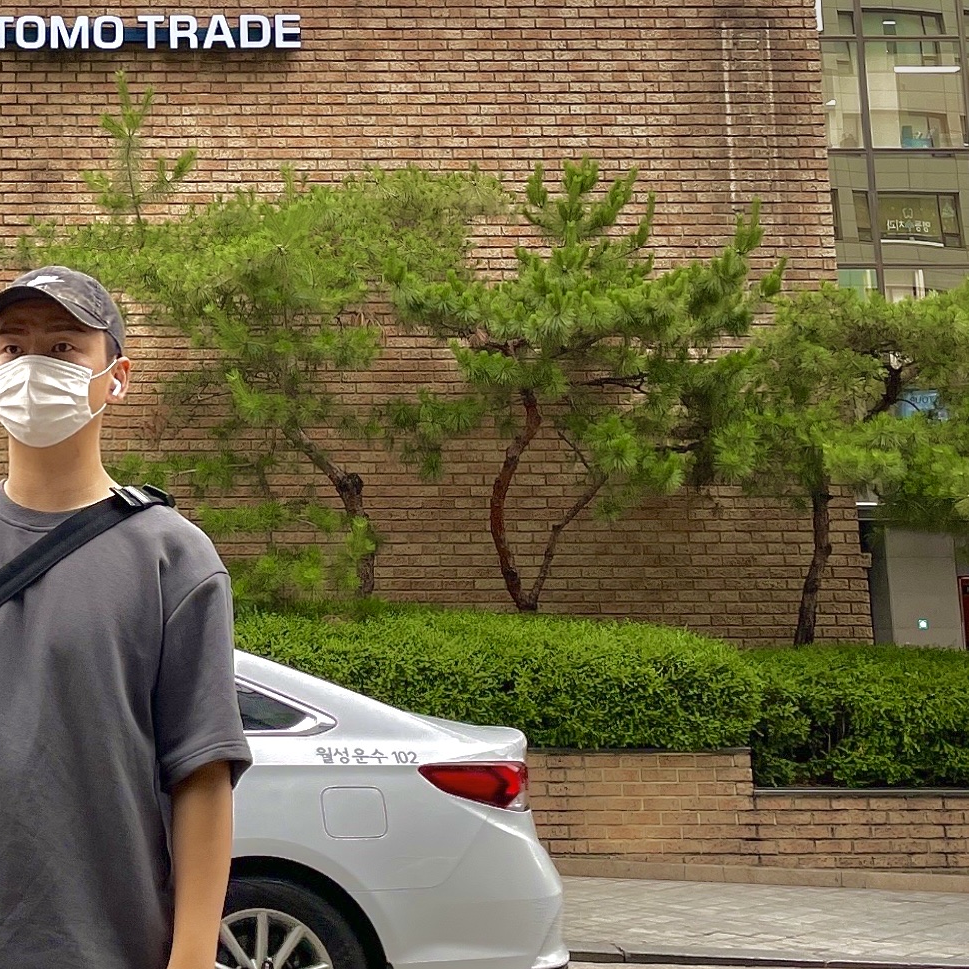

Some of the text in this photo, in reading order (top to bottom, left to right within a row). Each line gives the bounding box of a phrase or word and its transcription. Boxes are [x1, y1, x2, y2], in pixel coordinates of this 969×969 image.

[137, 14, 302, 50] TRADE
[315, 747, 419, 764] 월성운수 102
